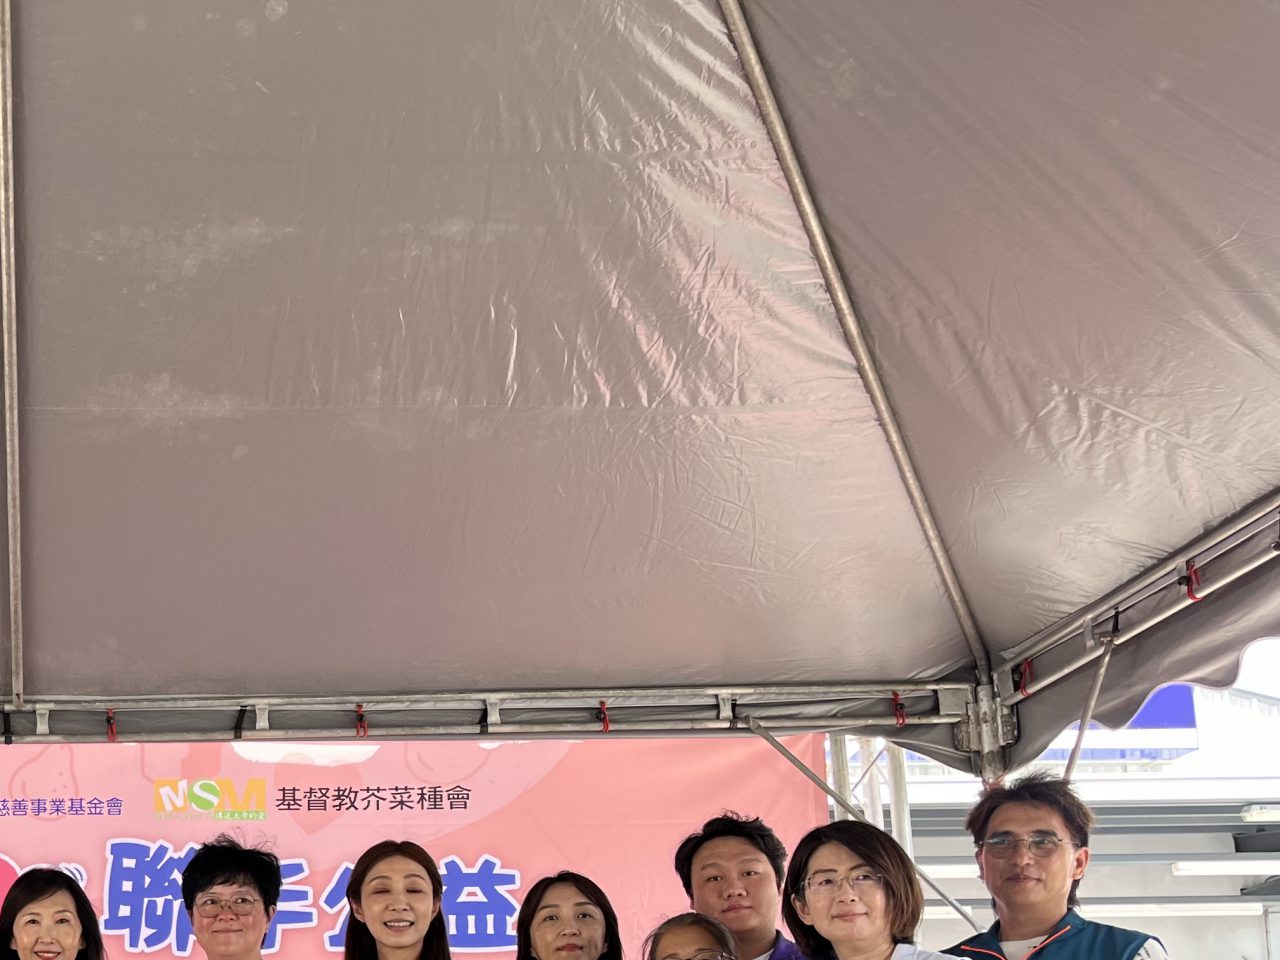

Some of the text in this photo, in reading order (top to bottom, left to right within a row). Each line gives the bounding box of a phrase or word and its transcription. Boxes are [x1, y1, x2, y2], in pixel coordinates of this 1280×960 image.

[276, 785, 472, 812] 基督教芥菜種會
